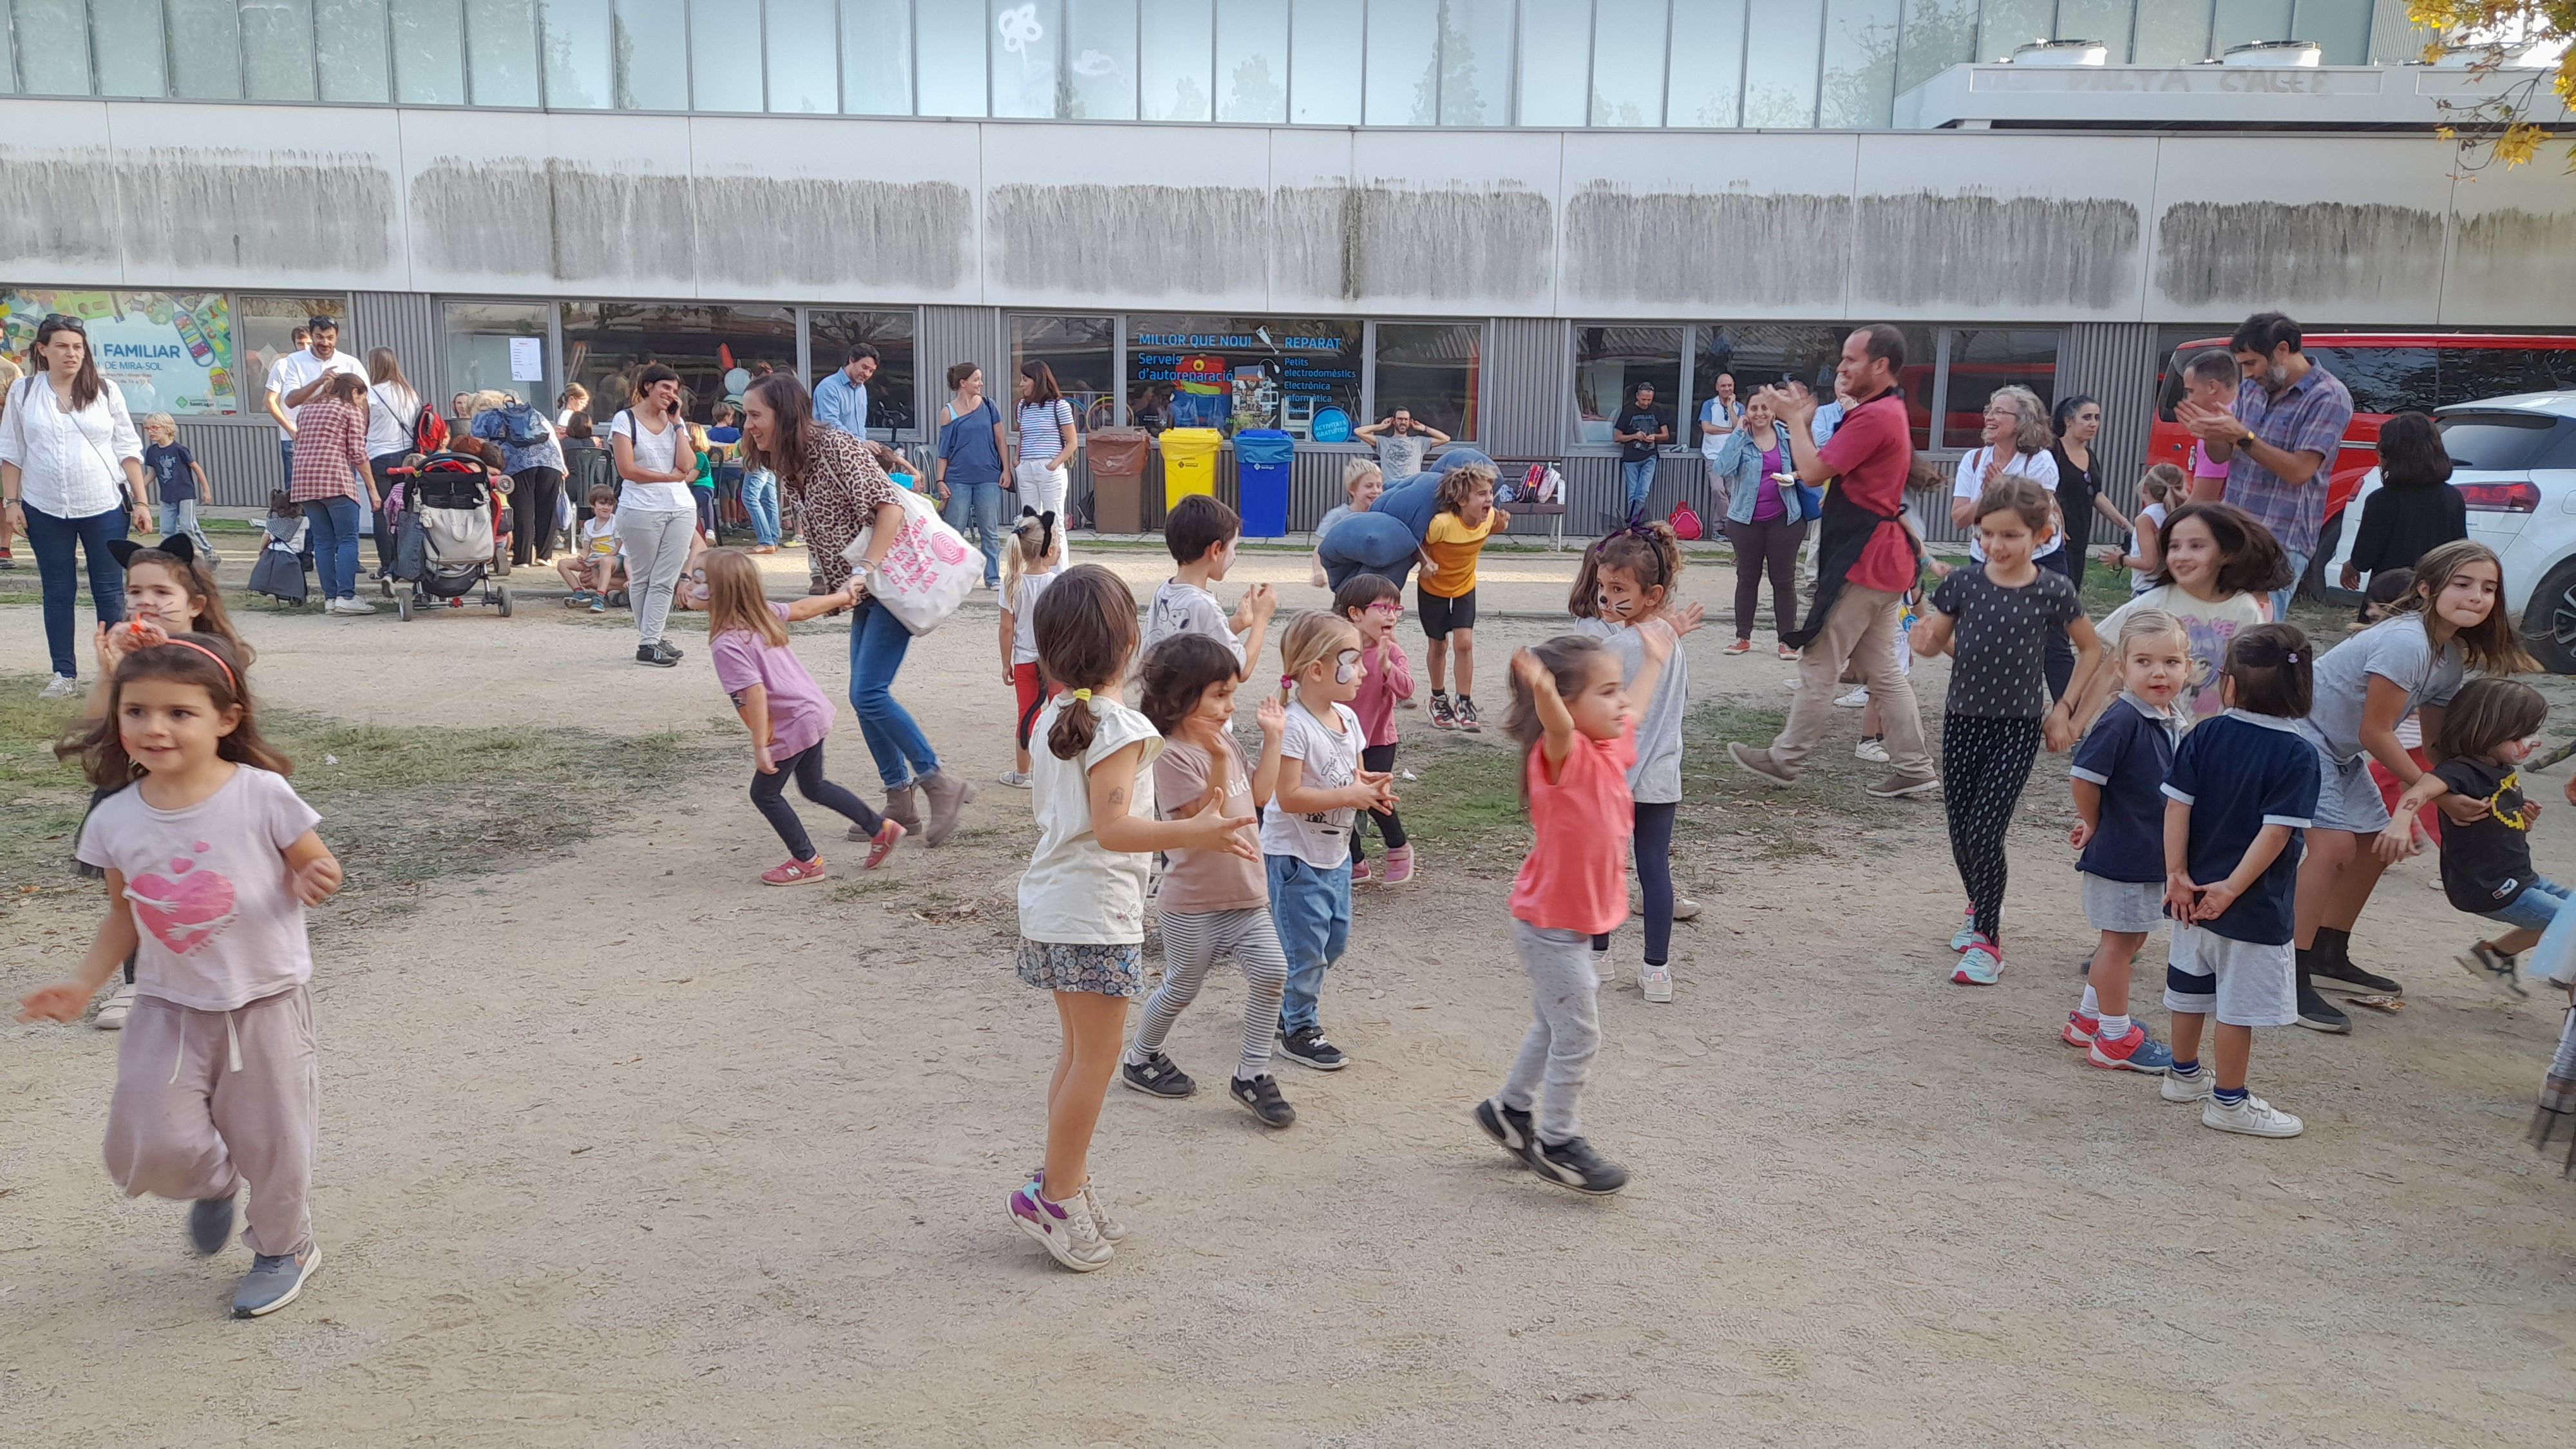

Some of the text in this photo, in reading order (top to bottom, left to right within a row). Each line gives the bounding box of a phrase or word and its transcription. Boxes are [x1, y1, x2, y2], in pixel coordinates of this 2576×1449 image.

[1139, 333, 1186, 346] MILLOR
[1190, 335, 1216, 348] QUE
[1285, 337, 1341, 348] REPARAT
[104, 343, 180, 359] FAMILIAR
[1138, 353, 1182, 365] Serveis
[1285, 357, 1309, 366] Petits
[105, 361, 117, 370] DE
[120, 361, 163, 371] MIRA-SOL
[1284, 368, 1356, 378] electrodomèstics
[1284, 381, 1331, 390] Electrònica
